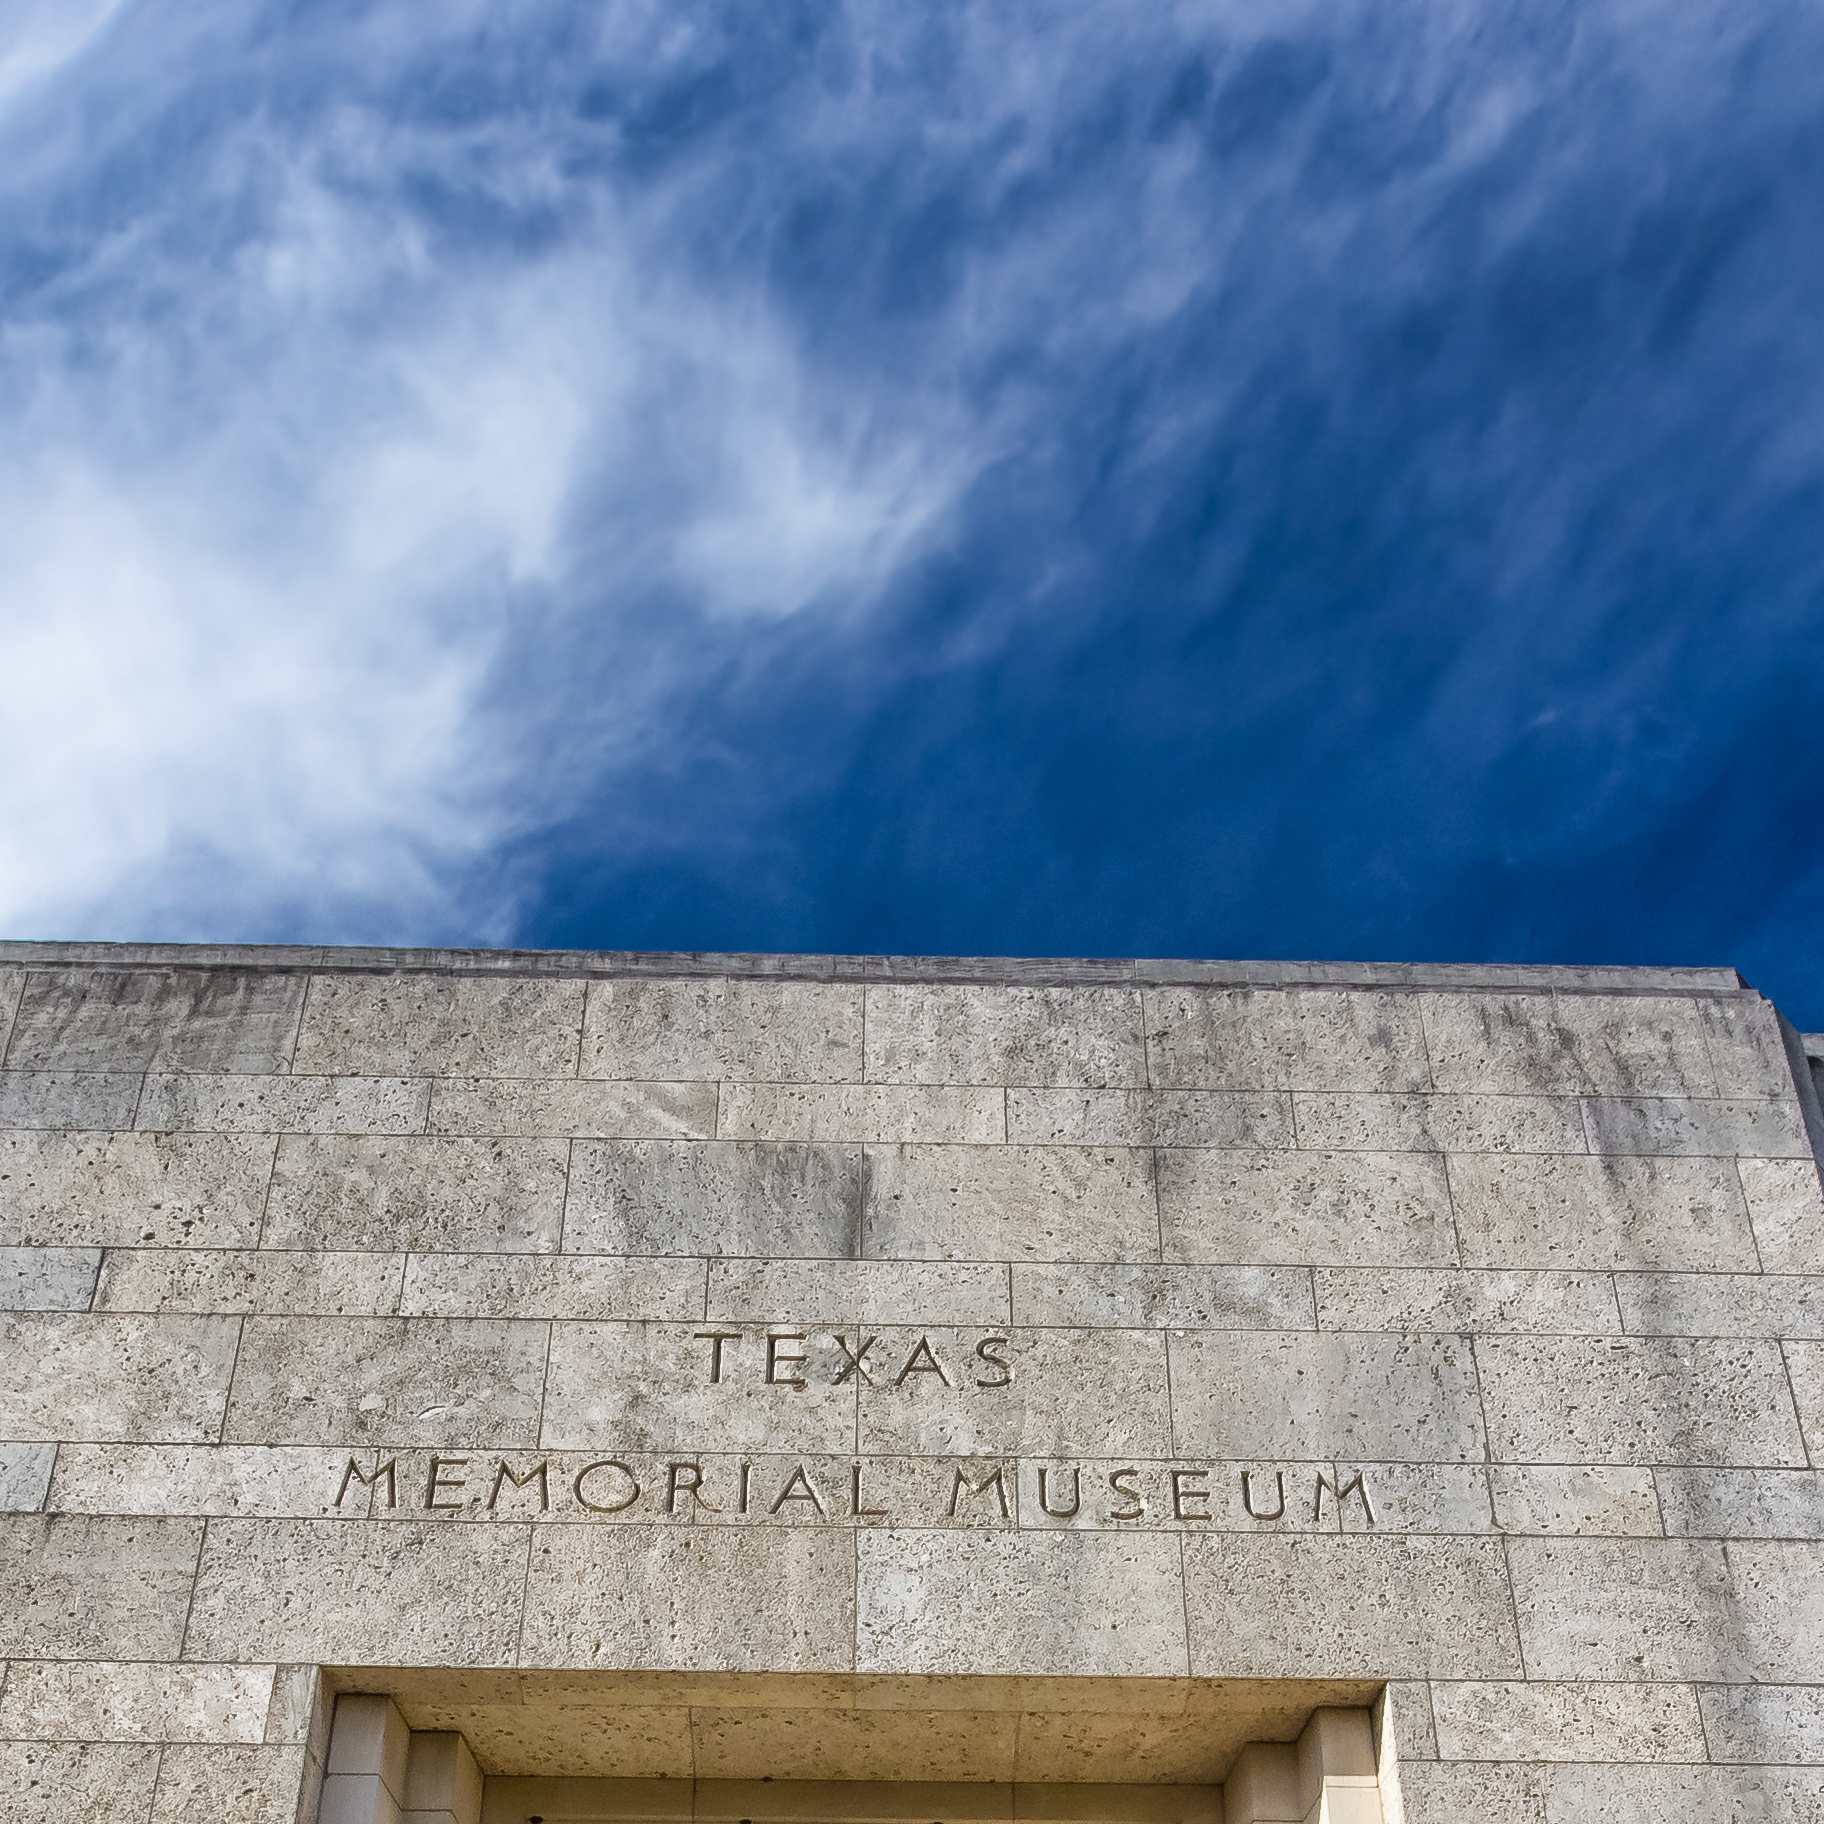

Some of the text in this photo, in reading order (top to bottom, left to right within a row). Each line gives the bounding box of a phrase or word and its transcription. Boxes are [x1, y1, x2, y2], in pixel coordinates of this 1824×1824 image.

[692, 1331, 1013, 1389] TEXAS
[333, 1454, 1378, 1526] MEMORIAL MUSEUM
